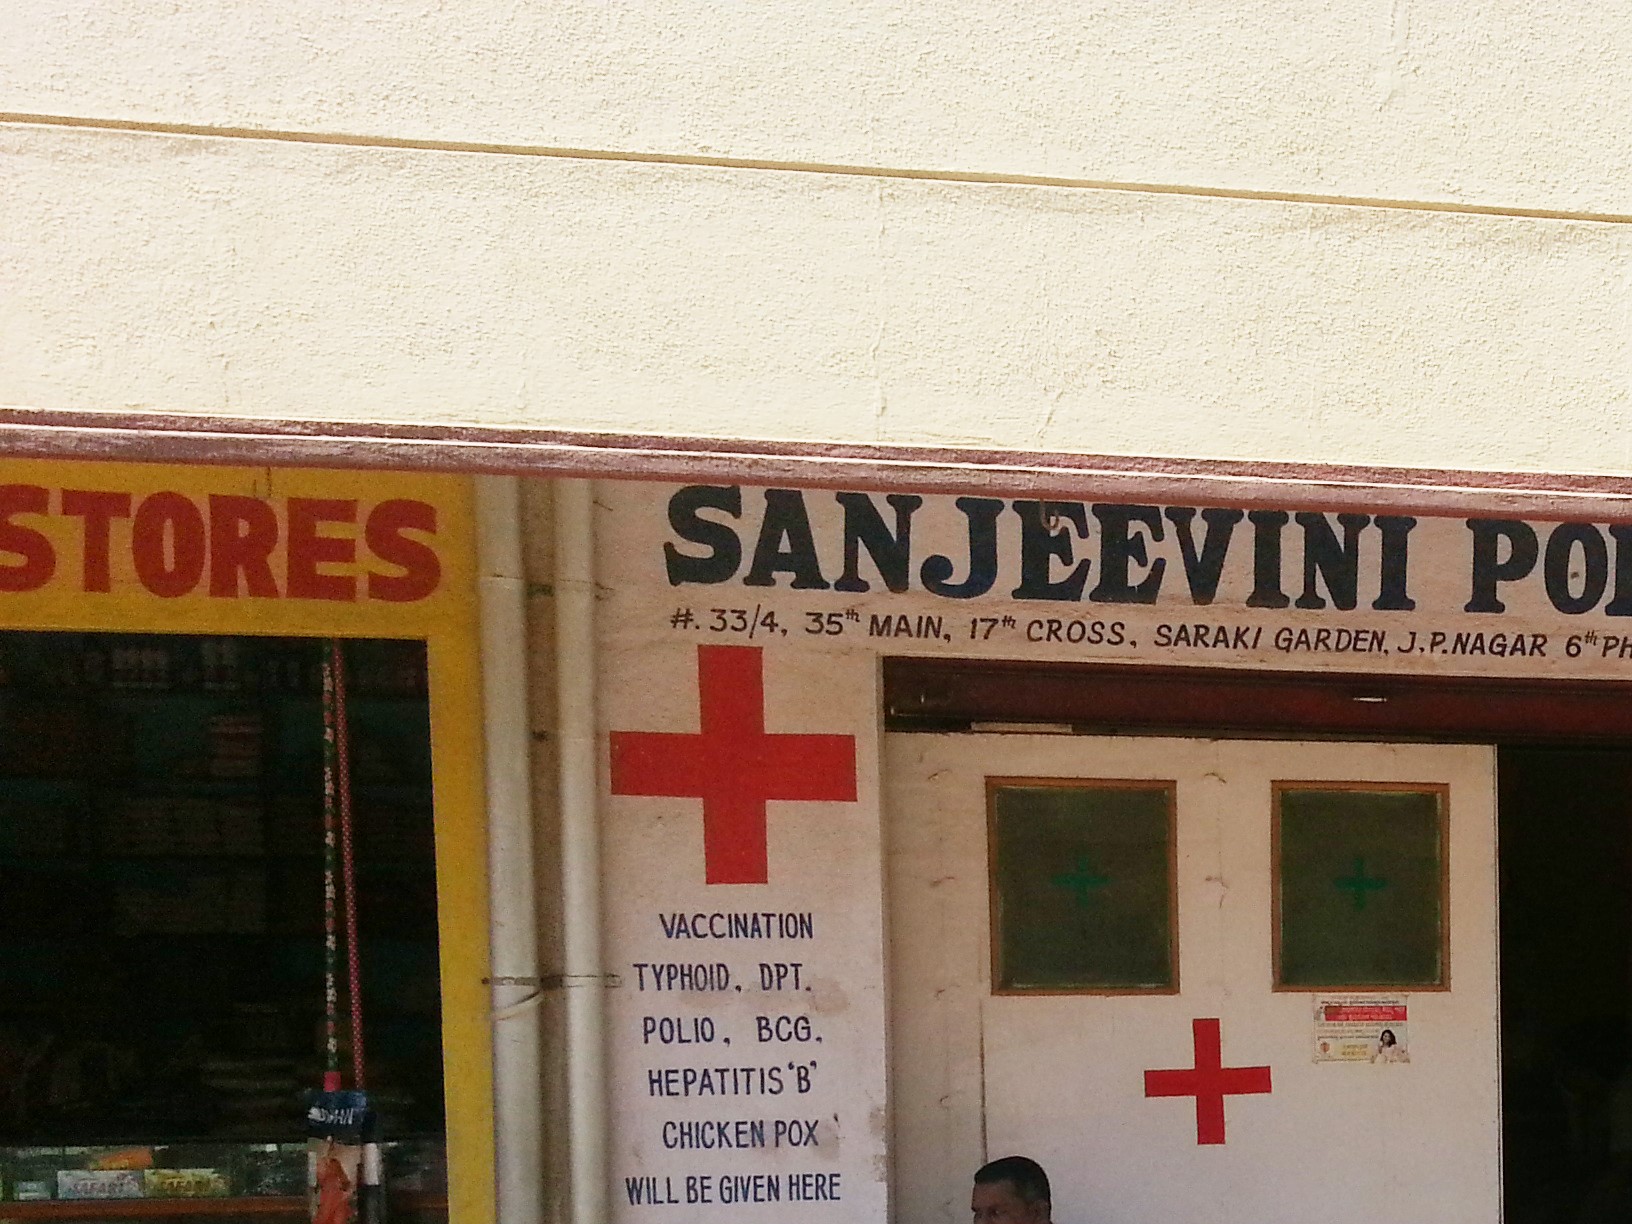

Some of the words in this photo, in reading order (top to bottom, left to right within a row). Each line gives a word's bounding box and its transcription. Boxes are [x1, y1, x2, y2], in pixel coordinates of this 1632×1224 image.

[0, 484, 441, 602] STORES
[664, 485, 1416, 612] SANJEEVINI
[1154, 625, 1262, 650] SARAKI
[659, 912, 814, 940] VACCINATION
[662, 1119, 766, 1150] CHICKEN
[774, 1119, 820, 1147] POX
[625, 1176, 679, 1206] WILL
[686, 1176, 712, 1204] BE
[719, 1175, 780, 1204] GIVEN
[788, 1173, 841, 1201] HERE
